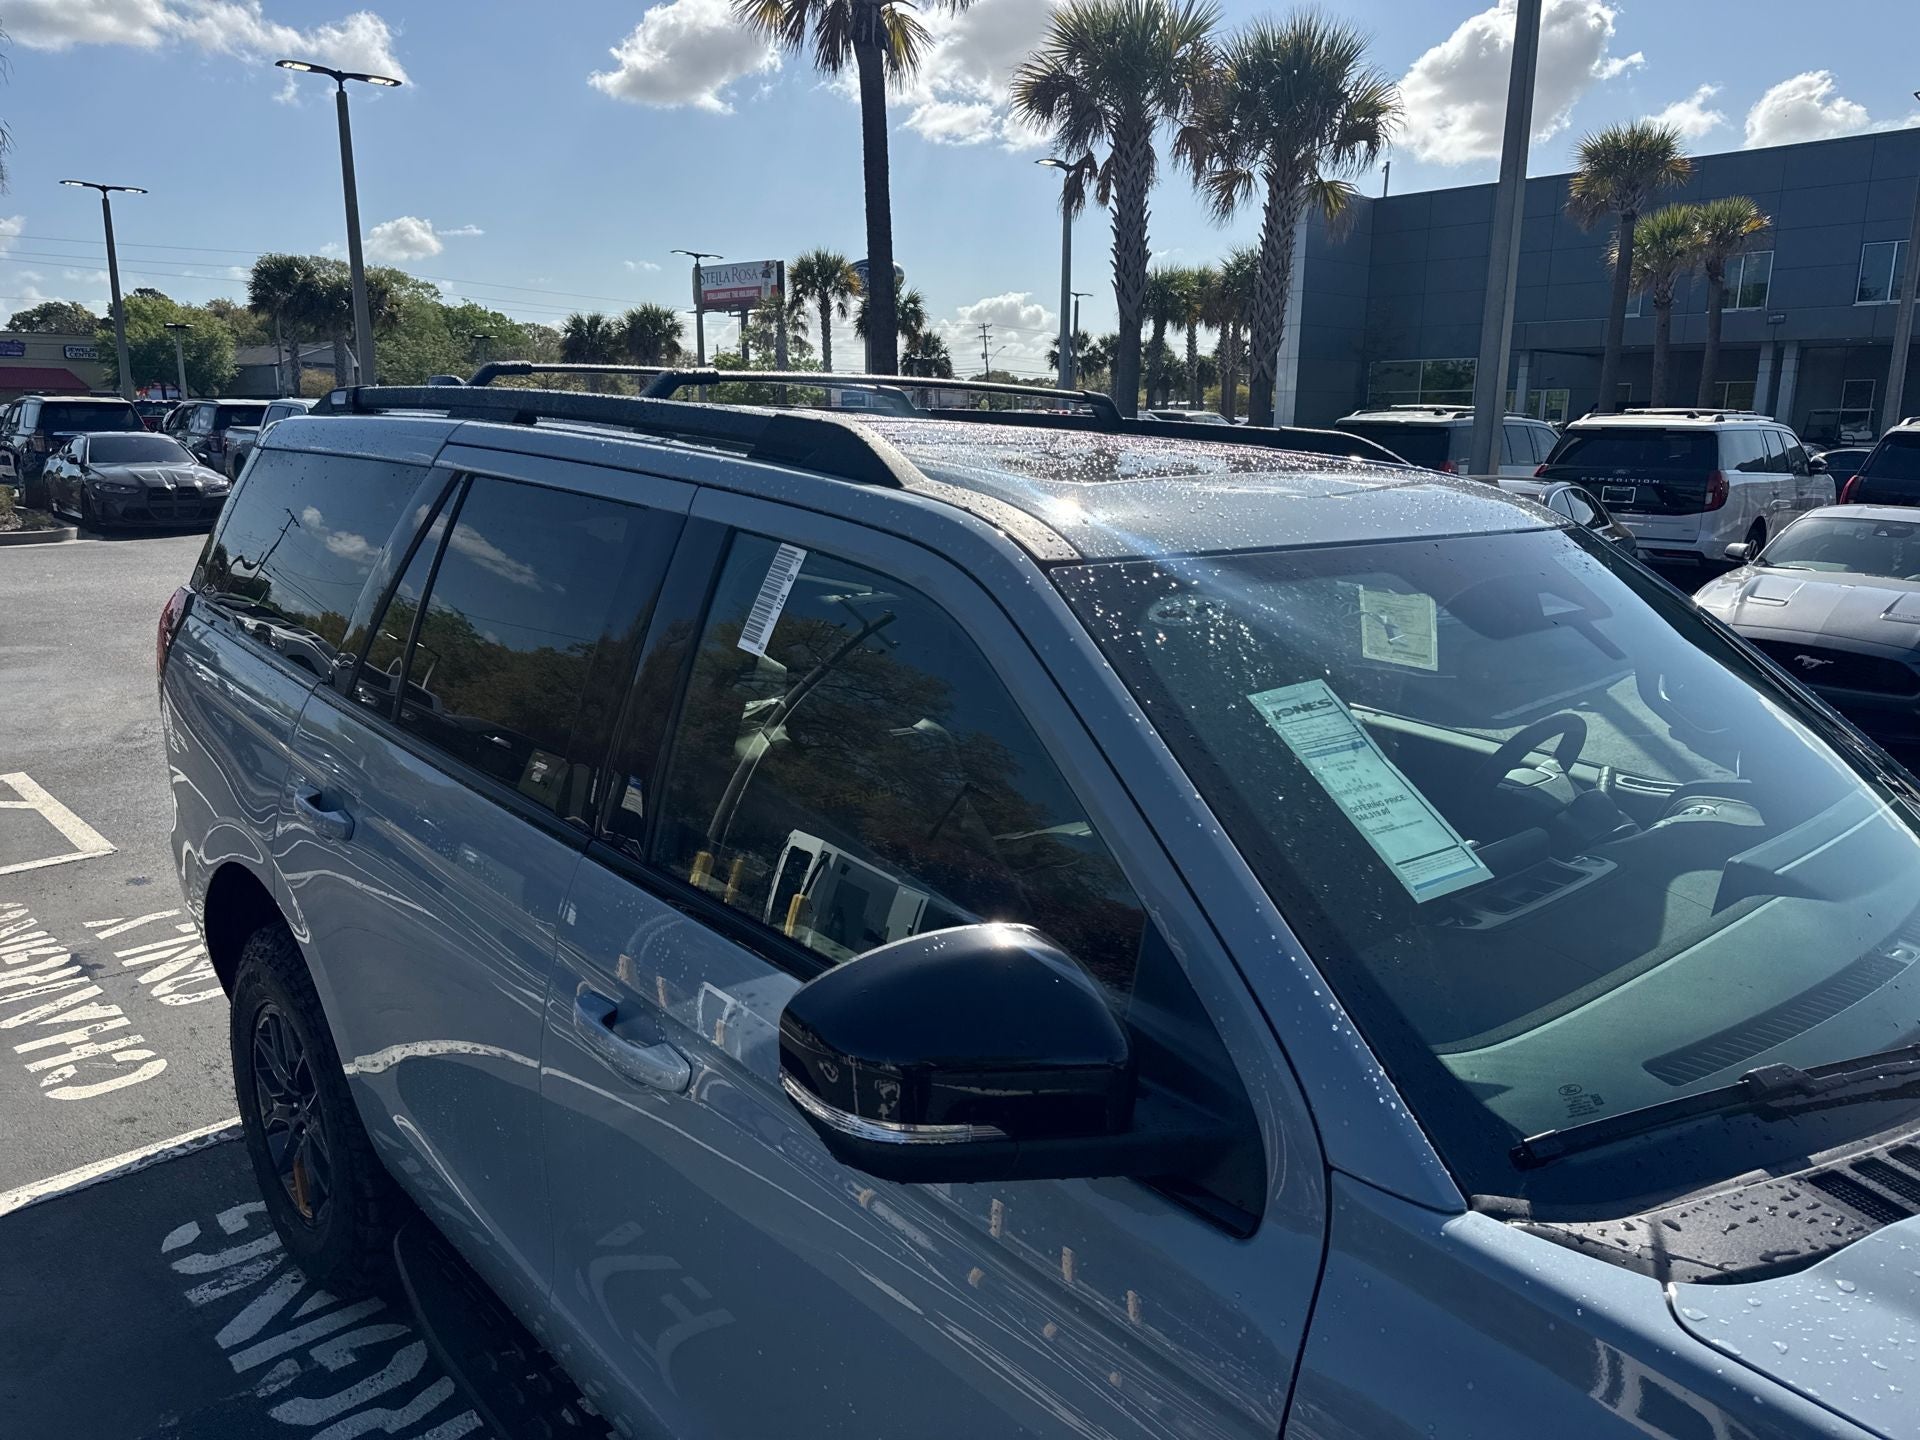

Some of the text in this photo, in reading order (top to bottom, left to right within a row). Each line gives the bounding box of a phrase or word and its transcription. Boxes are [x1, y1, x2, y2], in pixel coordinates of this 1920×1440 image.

[700, 266, 758, 285] STELLA ROSA
[1581, 476, 1660, 484] EXPEDITION
[776, 594, 786, 610] 1744
[1272, 699, 1333, 720] JONES
[1349, 800, 1385, 815] OFFERING
